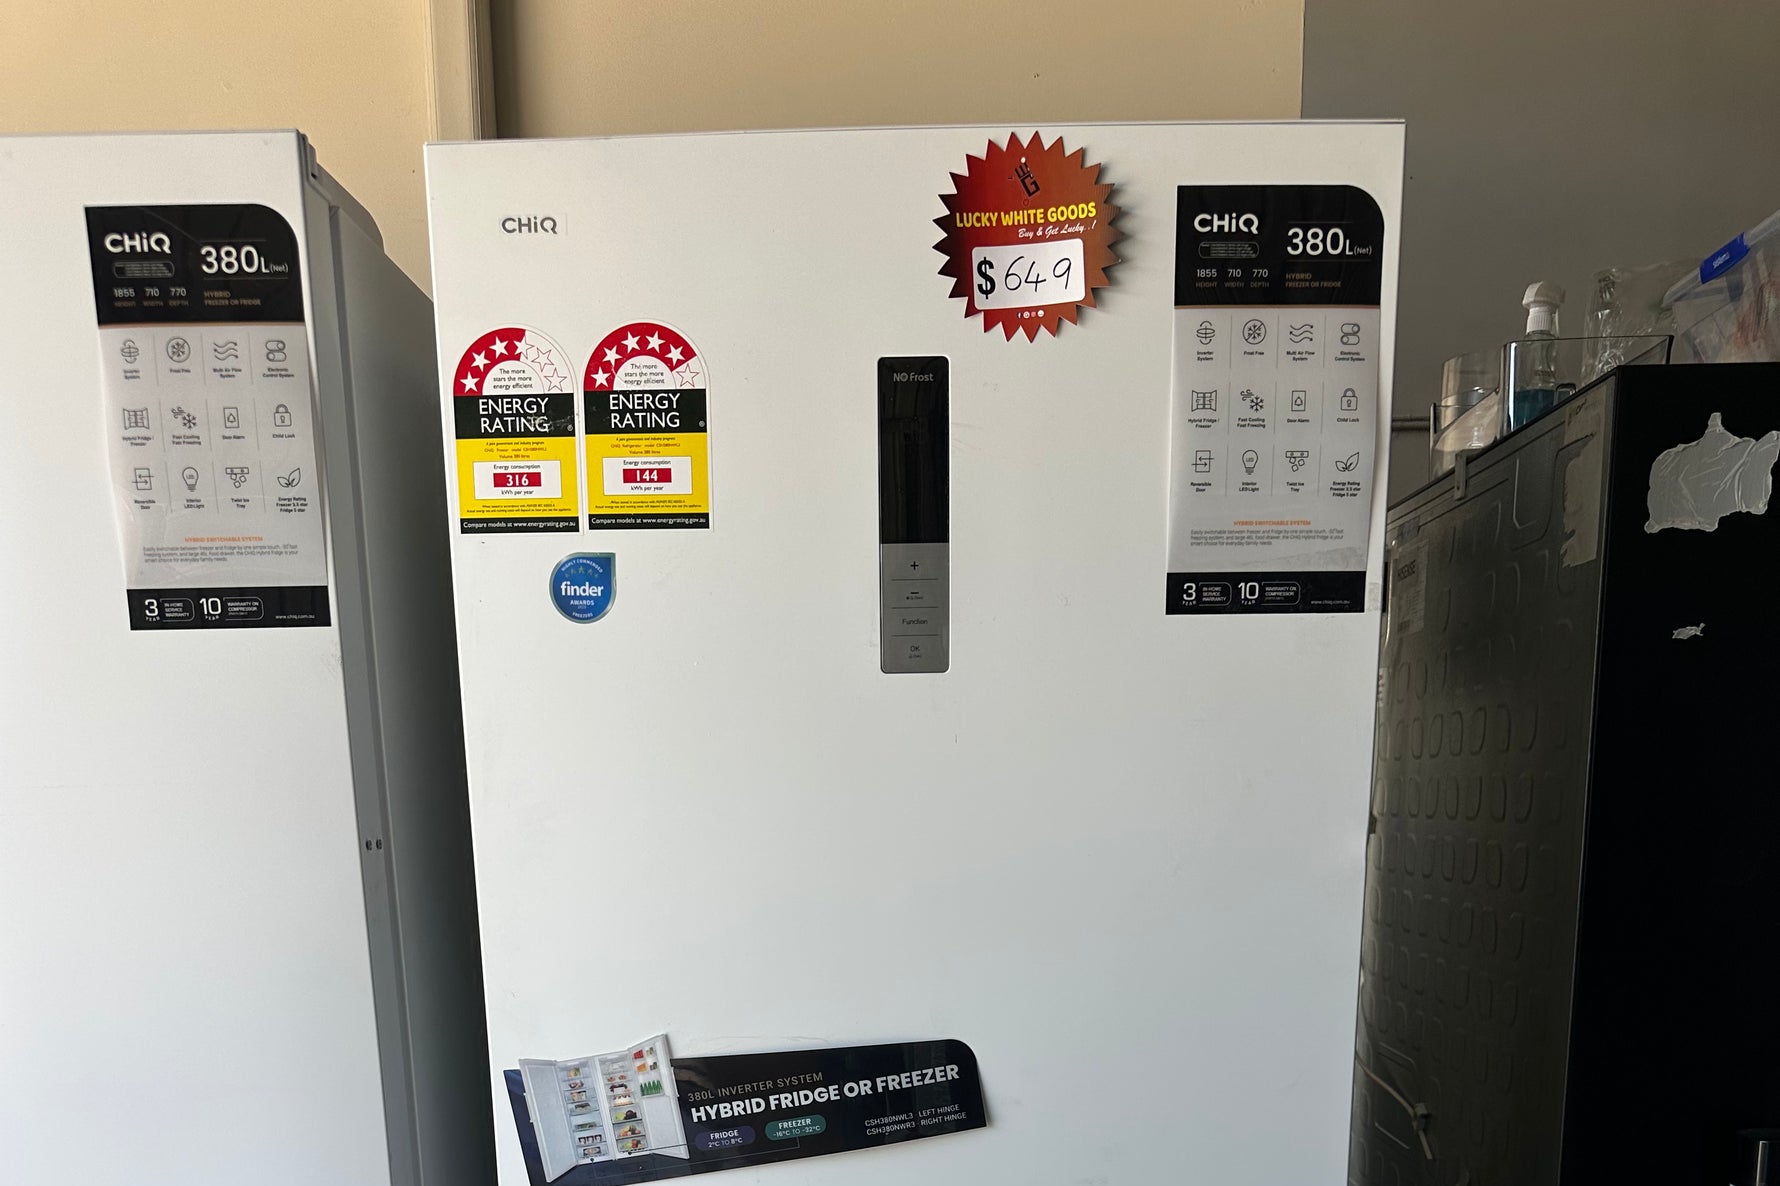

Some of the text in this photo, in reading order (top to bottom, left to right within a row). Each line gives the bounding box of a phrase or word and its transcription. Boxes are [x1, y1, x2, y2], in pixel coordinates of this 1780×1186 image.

[956, 201, 1097, 229] LUCKY WHITE GOODS
[1193, 212, 1259, 235] CHiQ
[501, 216, 558, 235] CHiQ
[1018, 229, 1034, 240] Buy
[1036, 227, 1043, 236] &
[1045, 226, 1059, 239] Get
[104, 232, 172, 254] CHiQ
[1196, 268, 1268, 278] 1855 710 770
[113, 287, 187, 298] 1855 710 770
[909, 373, 934, 382] Frost
[479, 397, 549, 414] ENERGY
[609, 392, 681, 410] ENERGY
[480, 416, 550, 433] RATING
[611, 411, 681, 429] RATING
[506, 474, 529, 486] 316
[636, 470, 658, 482] 144
[560, 580, 604, 597] finder
[1183, 582, 1196, 600] 3
[1238, 582, 1259, 599] 10
[144, 598, 158, 616] 3
[200, 597, 222, 615] 10
[687, 1072, 823, 1102] 380L INVERTER SYSTEM
[691, 1064, 960, 1122] HYBRID FRIDGE OR FREEZER
[778, 1118, 812, 1129] FREEZER
[864, 1104, 960, 1127] CSH380NWL3 LEFT HINGE
[866, 1112, 967, 1136] CSH380NWR3 RIGHT HINGE
[710, 1129, 740, 1140] FRIDGE
